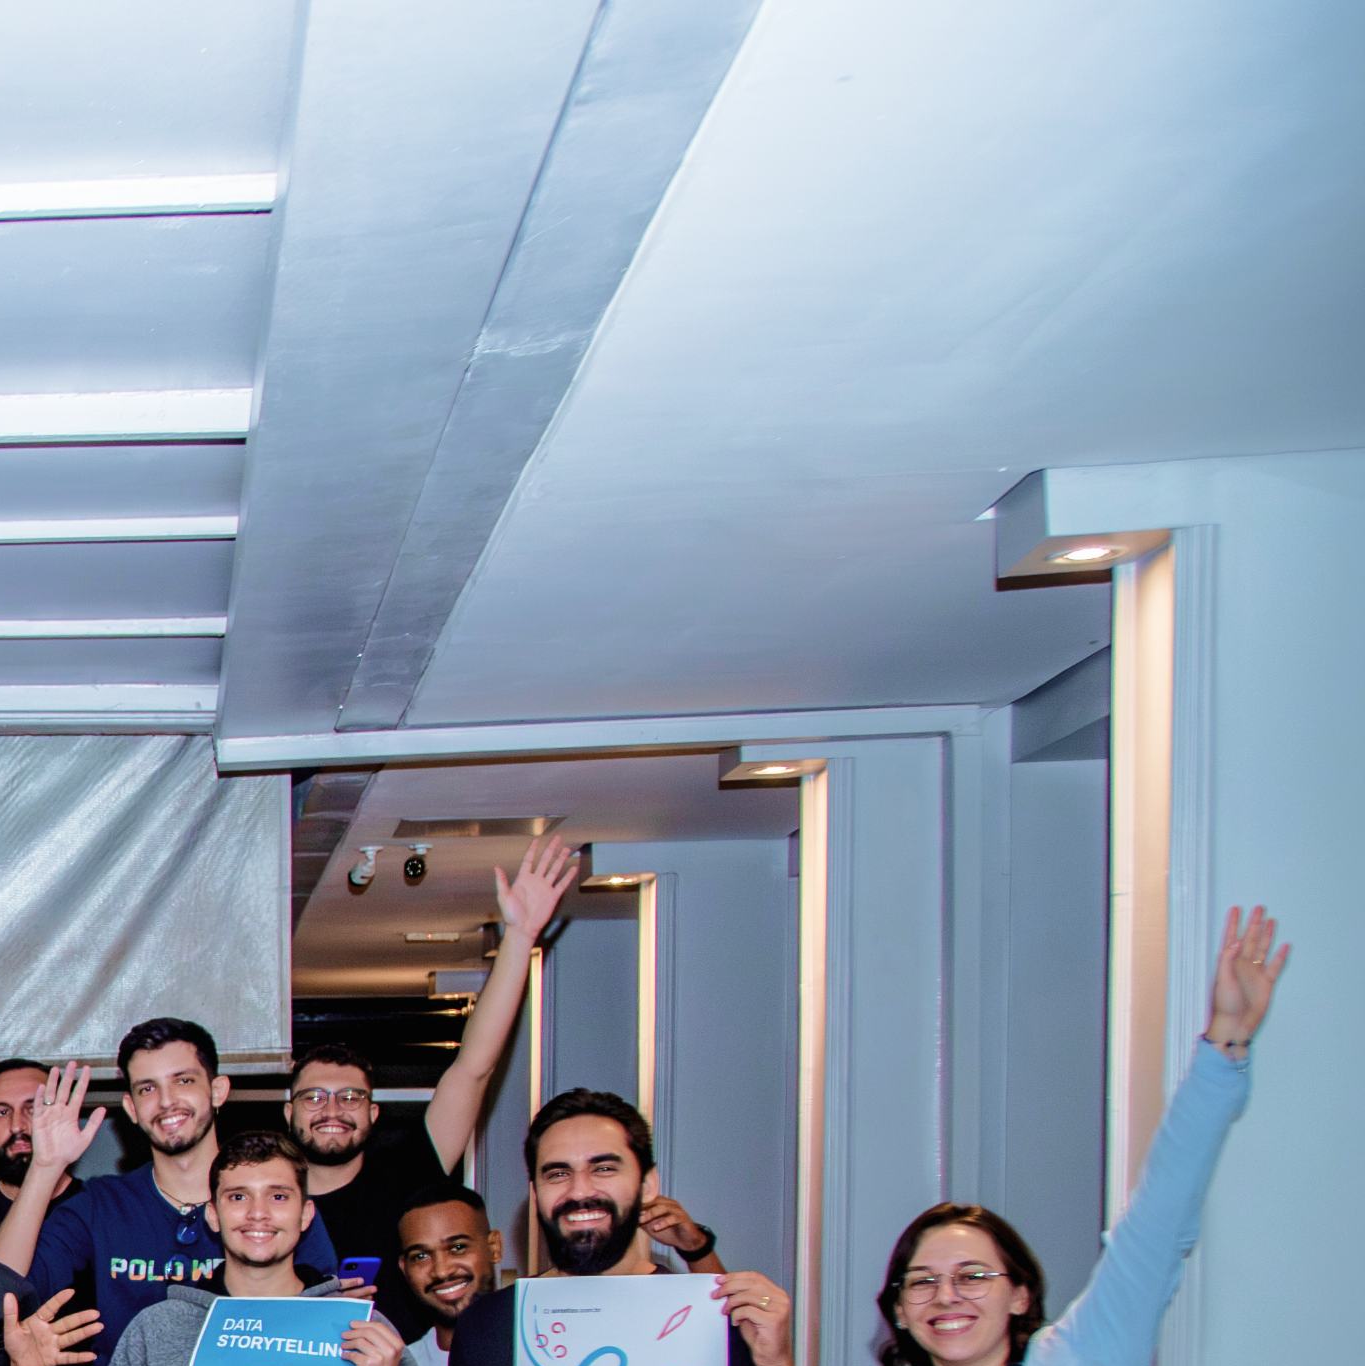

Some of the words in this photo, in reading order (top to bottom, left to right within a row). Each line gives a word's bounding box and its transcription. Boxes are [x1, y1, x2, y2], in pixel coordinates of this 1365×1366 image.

[110, 1258, 184, 1281] POLO
[222, 1318, 263, 1332] DATA
[216, 1334, 344, 1359] STORYTELLIN
